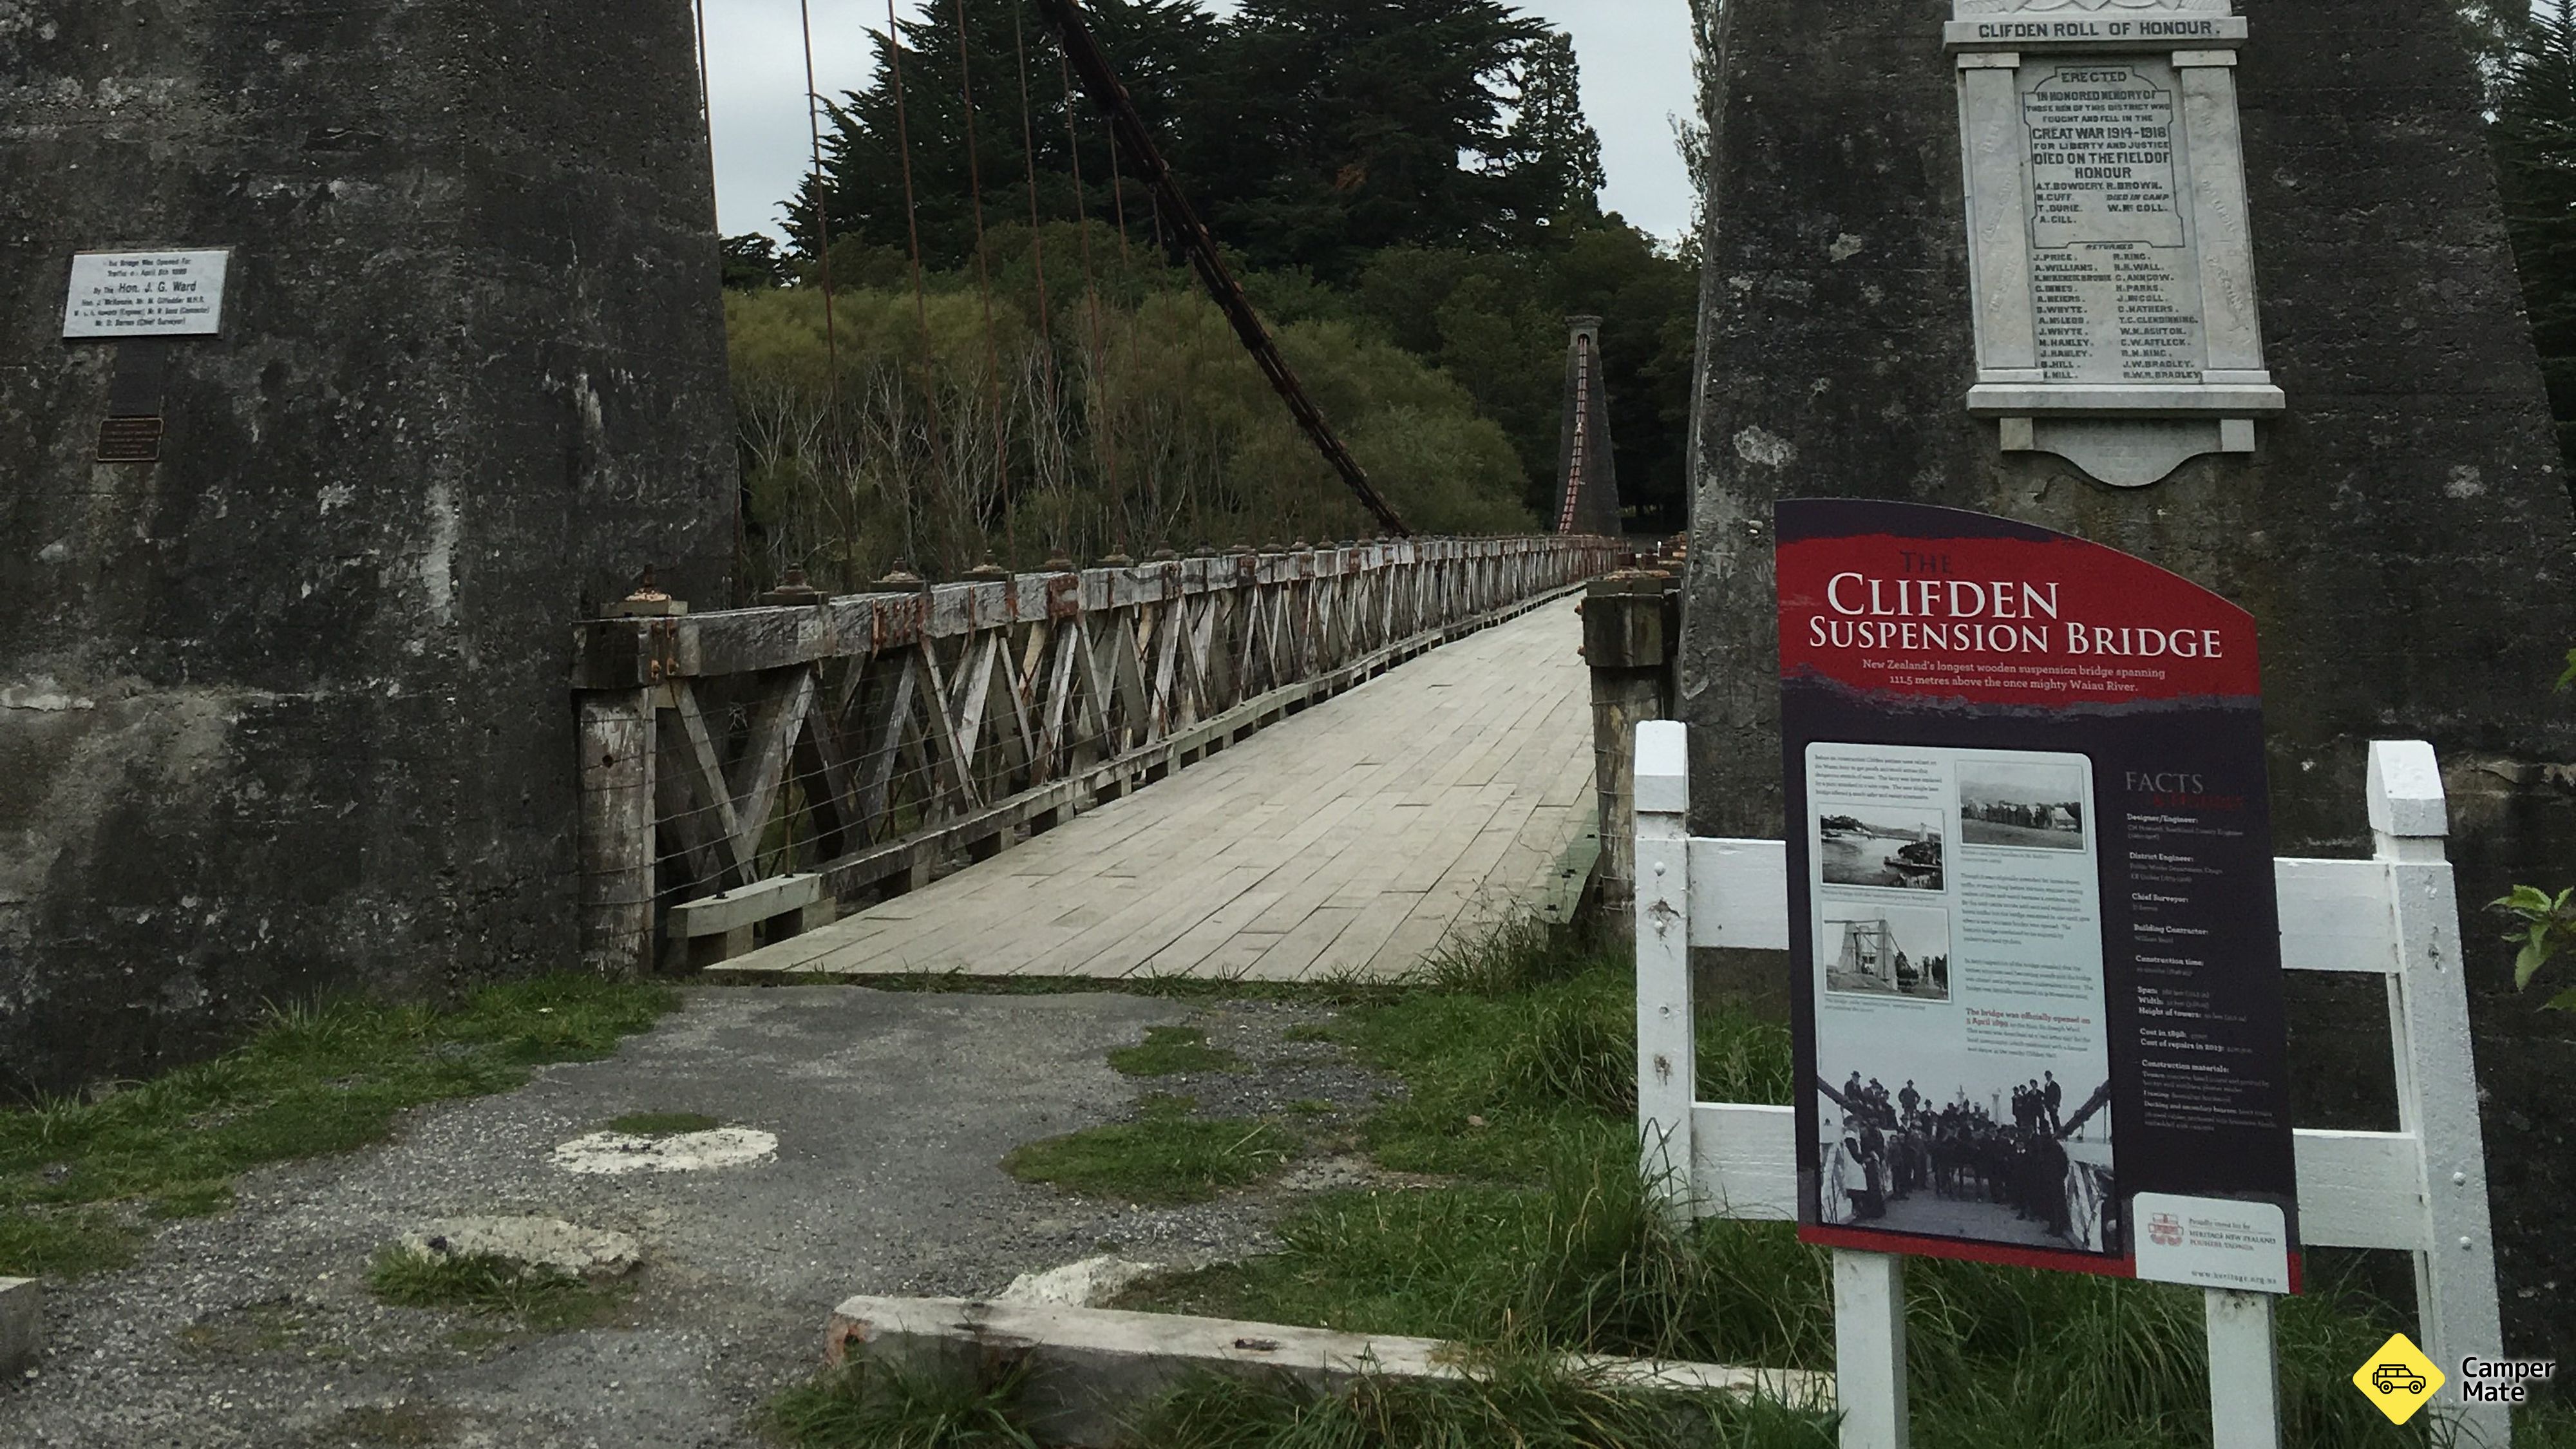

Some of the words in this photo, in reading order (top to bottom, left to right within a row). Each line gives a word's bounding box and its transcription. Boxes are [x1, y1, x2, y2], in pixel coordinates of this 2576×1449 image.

[1979, 23, 2047, 37] CLIFDEN
[2054, 23, 2099, 37] ROLL
[2109, 23, 2131, 35] OF
[2061, 71, 2126, 82] ERECTED
[2038, 91, 2048, 101] IN
[2050, 91, 2099, 101] HONORED
[2101, 90, 2142, 100] MEMORY
[2143, 90, 2157, 100] OF
[2032, 128, 2074, 139] GREAT
[2076, 128, 2105, 139] WAR
[2107, 127, 2166, 139] 1914-1918
[2034, 153, 2064, 164] DIED
[2067, 153, 2085, 164] ON
[2088, 153, 2115, 164] THE
[2117, 152, 2156, 164] FIELD
[2157, 152, 2170, 163] OF
[2075, 167, 2132, 178] HONOUR
[173, 280, 197, 292] Ward
[1900, 551, 1953, 574] THE
[1827, 573, 2060, 620] CLIFDEN
[1810, 615, 2049, 654] SUSPENSION
[2066, 621, 2223, 659] BRIDGE
[1862, 659, 1884, 669] New
[1887, 659, 1935, 670] Zealand's
[1937, 661, 1975, 674] longest
[1976, 663, 2016, 673] wooden
[2019, 665, 2077, 676] suspension
[2079, 665, 2114, 678] bridge
[2116, 667, 2165, 679] spanning
[1889, 676, 1913, 685] 111.5
[1915, 676, 1949, 685] metres
[1952, 676, 1982, 687] above
[1984, 676, 2001, 687] the
[2003, 679, 2028, 688] once
[2030, 679, 2067, 691] mighty
[2070, 679, 2104, 690] Waiau
[2106, 681, 2139, 692] River.
[2125, 772, 2204, 794] FACTS
[2129, 851, 2157, 860] District
[2134, 923, 2164, 934] Building
[2136, 955, 2184, 965] Construction
[1966, 1007, 1980, 1016] The
[1981, 1009, 2003, 1018] bridge
[2021, 1011, 2052, 1022] officially
[2053, 1014, 2079, 1023] opened
[2139, 1007, 2163, 1016] Height
[2168, 1041, 2194, 1050] repairs
[2142, 1059, 2190, 1070] Construction
